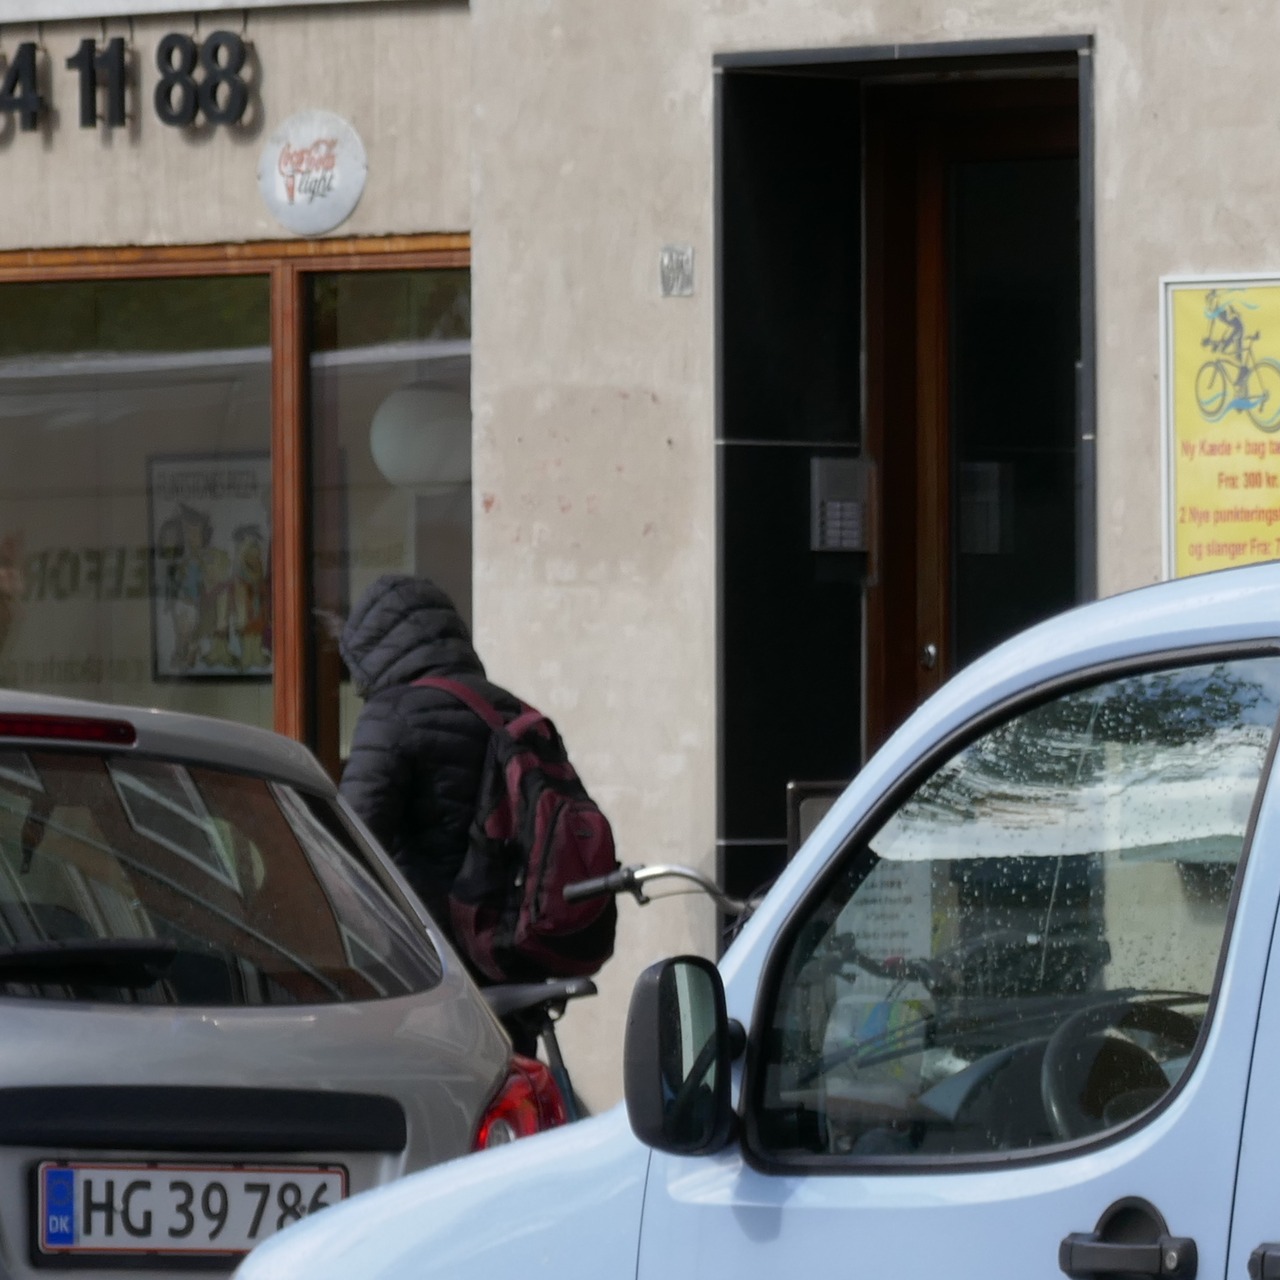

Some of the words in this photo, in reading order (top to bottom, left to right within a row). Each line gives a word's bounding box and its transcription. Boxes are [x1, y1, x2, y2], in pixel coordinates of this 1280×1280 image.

[66, 38, 126, 128] 11
[154, 31, 248, 127] 88
[49, 1214, 70, 1234] DK
[82, 1179, 152, 1238] HG
[168, 1181, 229, 1241] 39
